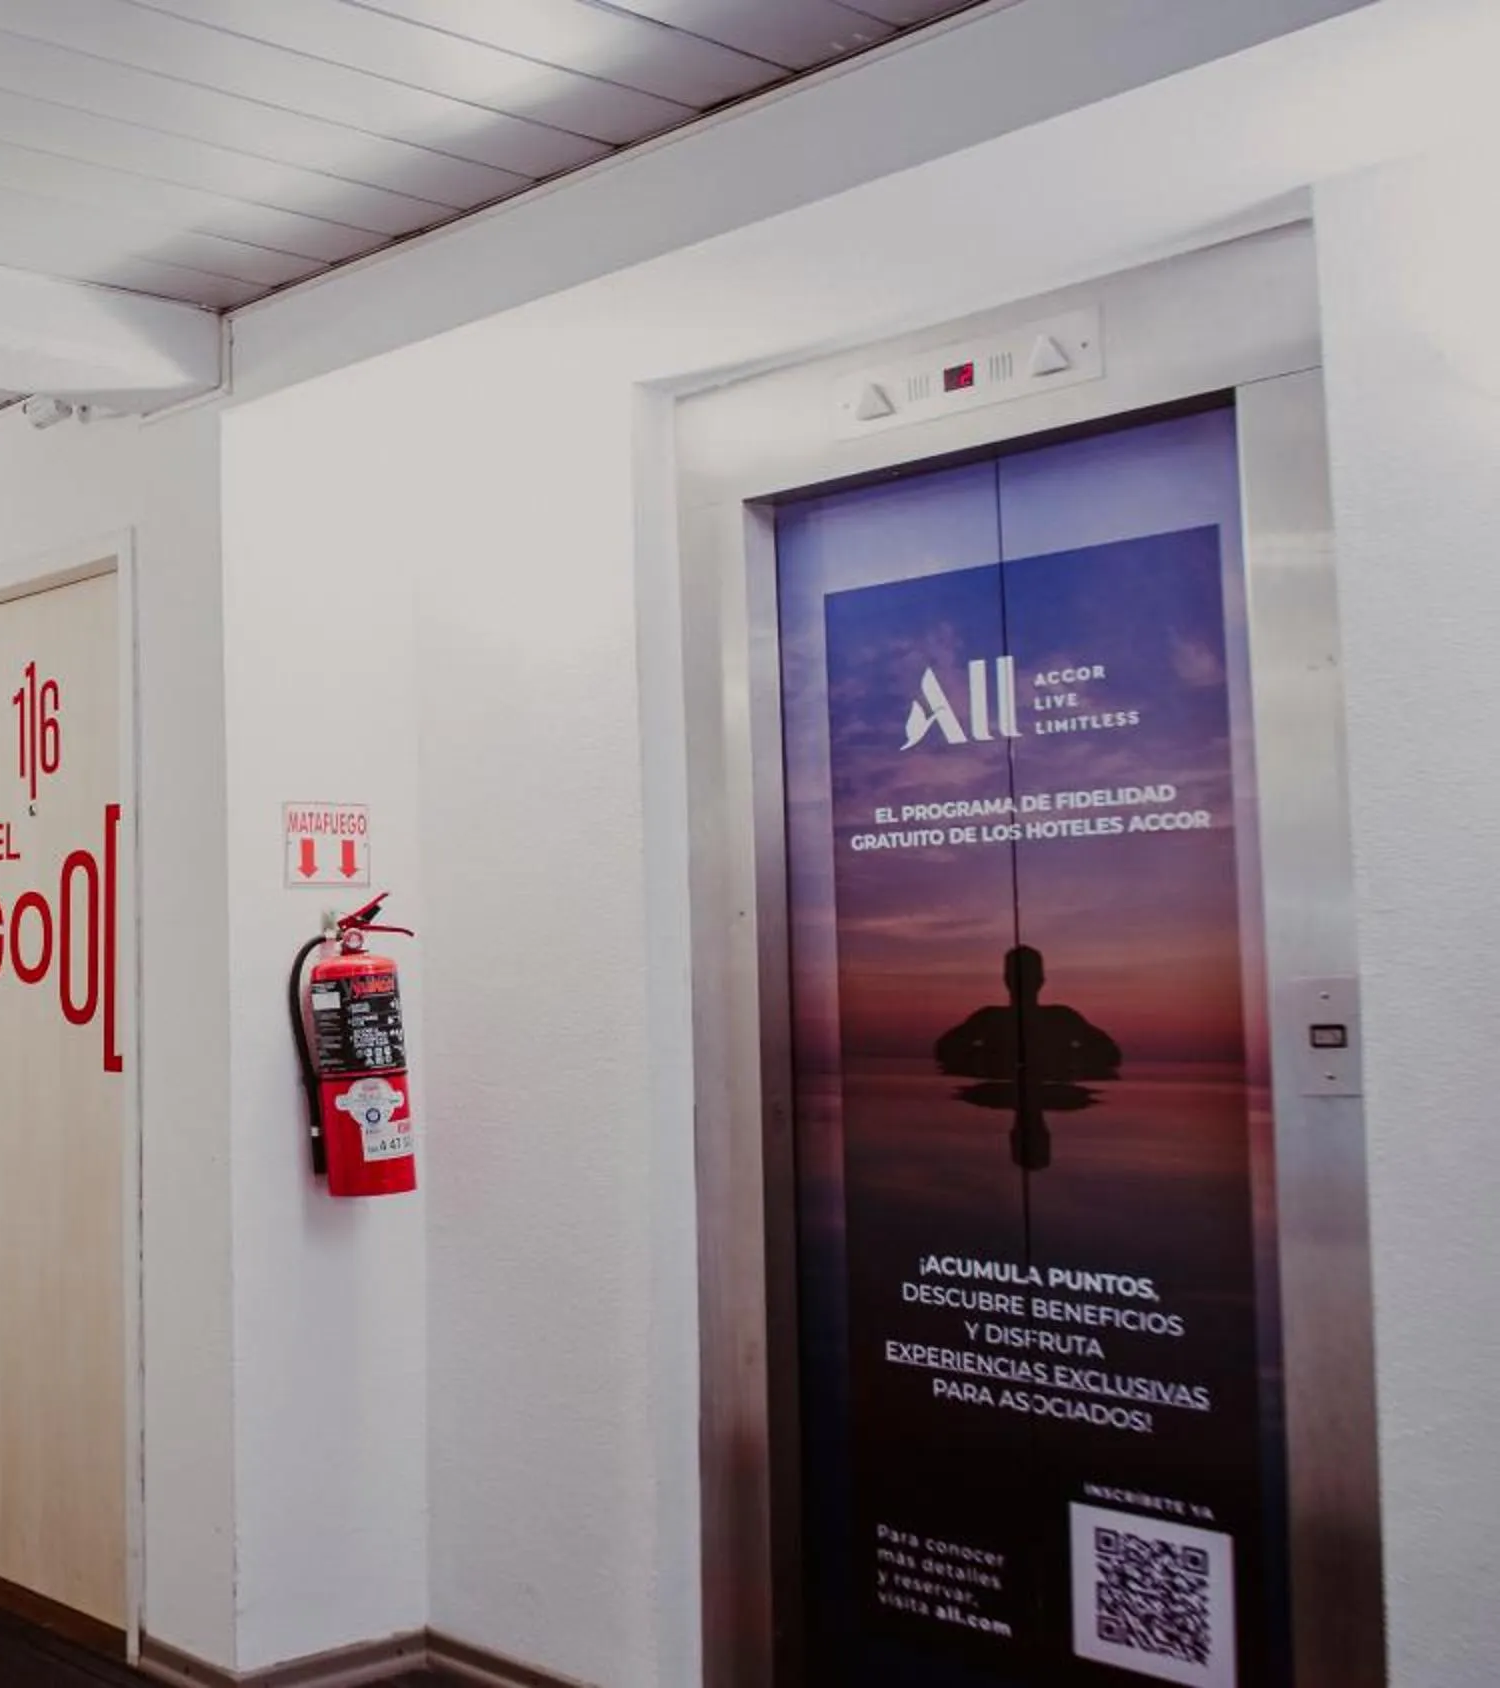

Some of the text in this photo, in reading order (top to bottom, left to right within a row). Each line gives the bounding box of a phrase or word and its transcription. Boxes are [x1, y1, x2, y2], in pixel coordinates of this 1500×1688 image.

[1034, 665, 1106, 687] ACCOR
[1034, 693, 1080, 711] LIVE
[13, 661, 60, 800] 116
[1035, 711, 1140, 735] LIMITLESS
[288, 811, 367, 835] MATAFUEGO
[875, 784, 1177, 824] EL PROGRAMA DE FIDELIDAD
[851, 810, 1212, 851] GRATUITO DE LOS HOTELES ACCOR
[919, 1254, 1161, 1302] ¡ACUMULA PUNTOS,
[901, 1281, 1186, 1338] DESCUBRE BENEFICIOS
[963, 1319, 1106, 1361] Y DISFRUTA
[884, 1340, 1212, 1409] EXPERIENCIAS EXCLUSIVAS
[932, 1377, 995, 1407] PARA
[876, 1523, 1005, 1567] Para conocer
[876, 1568, 889, 1587] y
[921, 1557, 1003, 1591] detalles
[876, 1591, 1014, 1639] visita all.com
